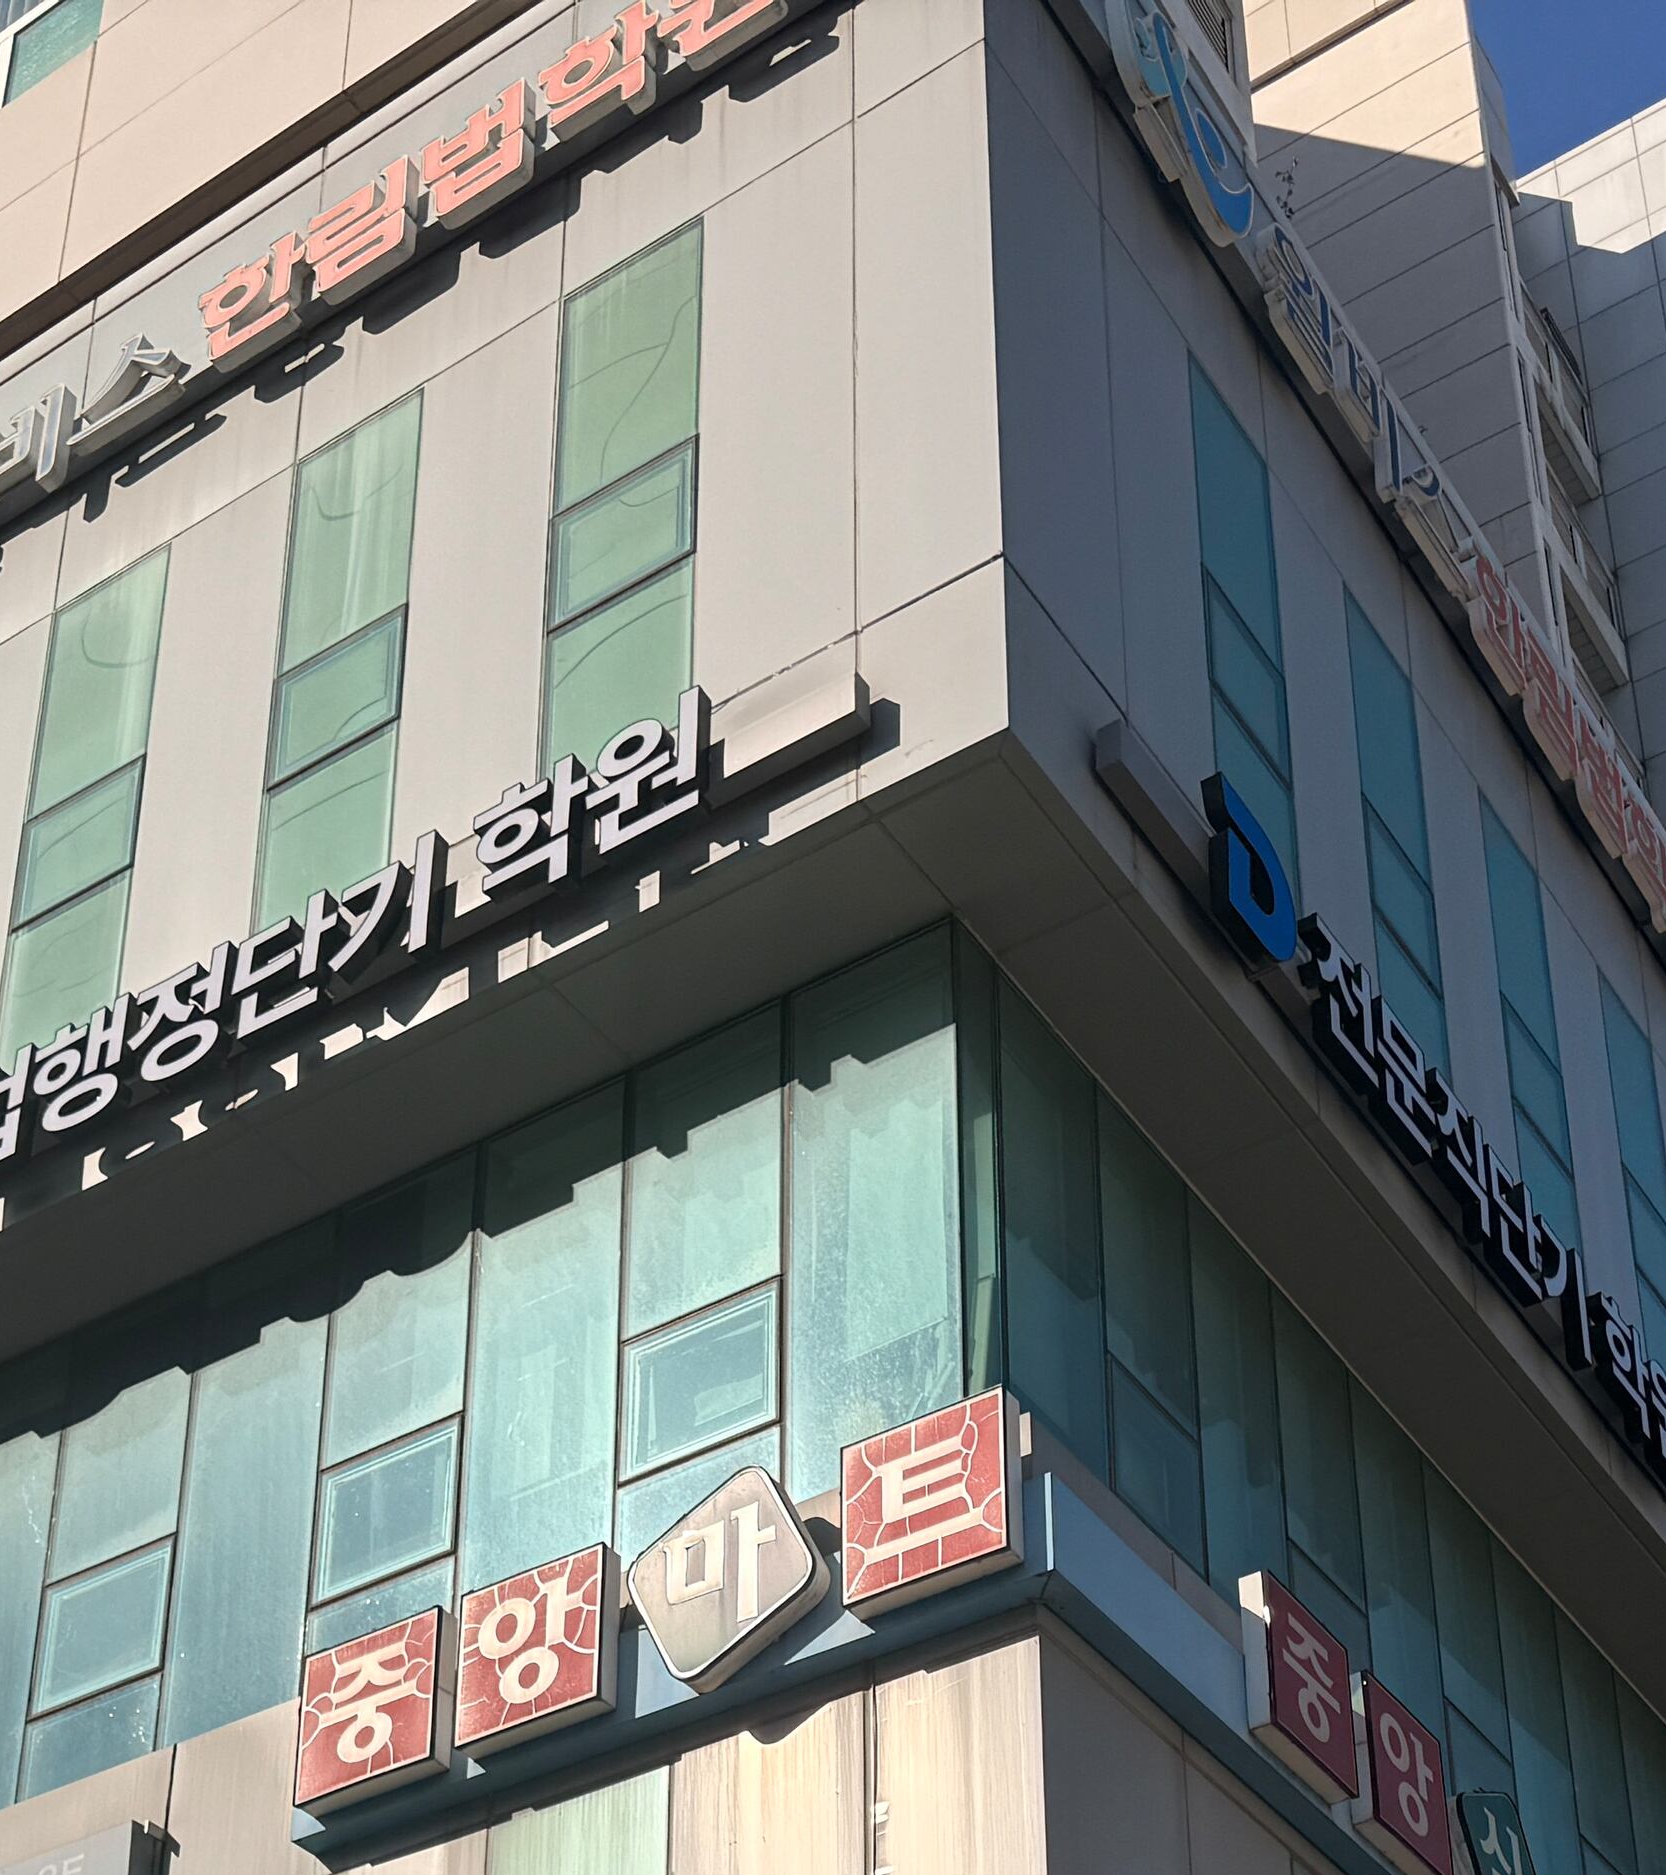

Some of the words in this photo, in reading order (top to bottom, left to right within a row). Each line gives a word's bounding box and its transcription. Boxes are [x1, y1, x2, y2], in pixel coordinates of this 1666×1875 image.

[1259, 224, 1474, 599] 윌비스
[473, 686, 711, 890] 학원
[1303, 914, 1592, 1368] 전문직단기
[316, 1432, 985, 1765] 중앙마트
